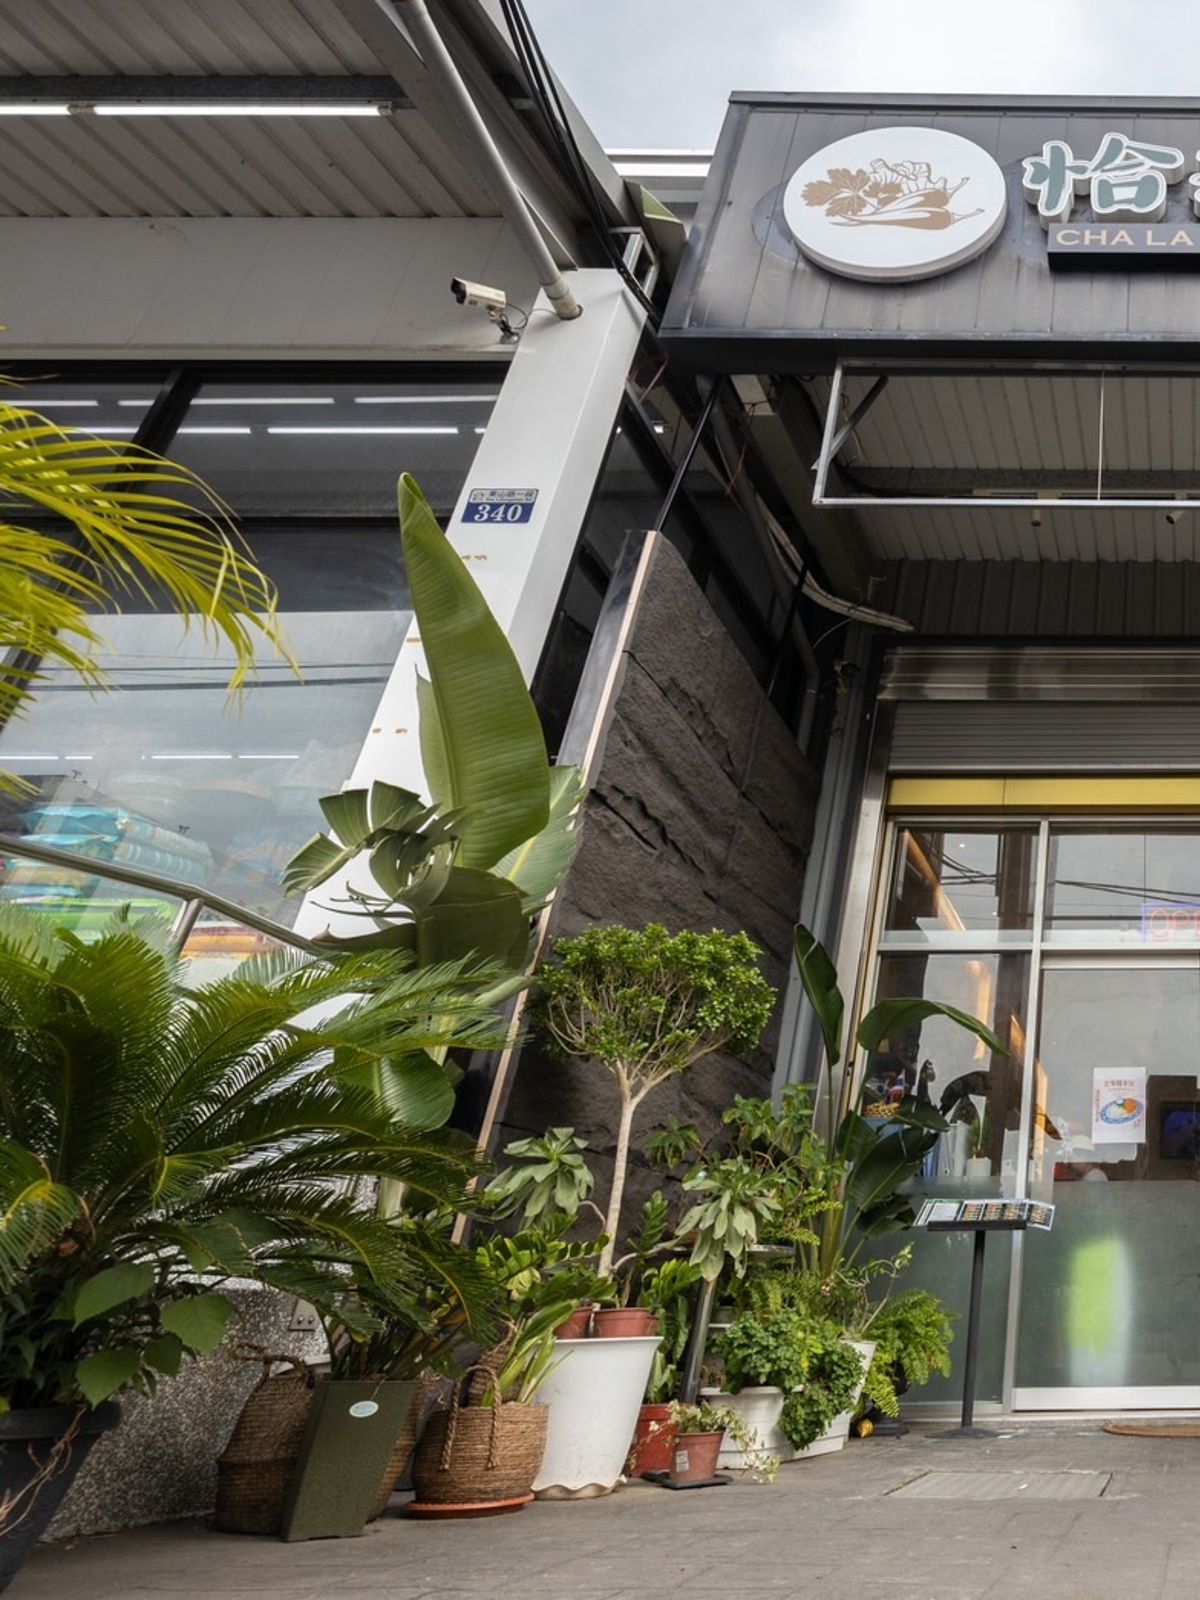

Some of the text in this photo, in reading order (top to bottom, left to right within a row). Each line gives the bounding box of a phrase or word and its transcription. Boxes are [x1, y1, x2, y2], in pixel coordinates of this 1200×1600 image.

[1055, 230, 1135, 246] CHA
[1145, 230, 1194, 246] LA
[474, 504, 523, 522] 340
